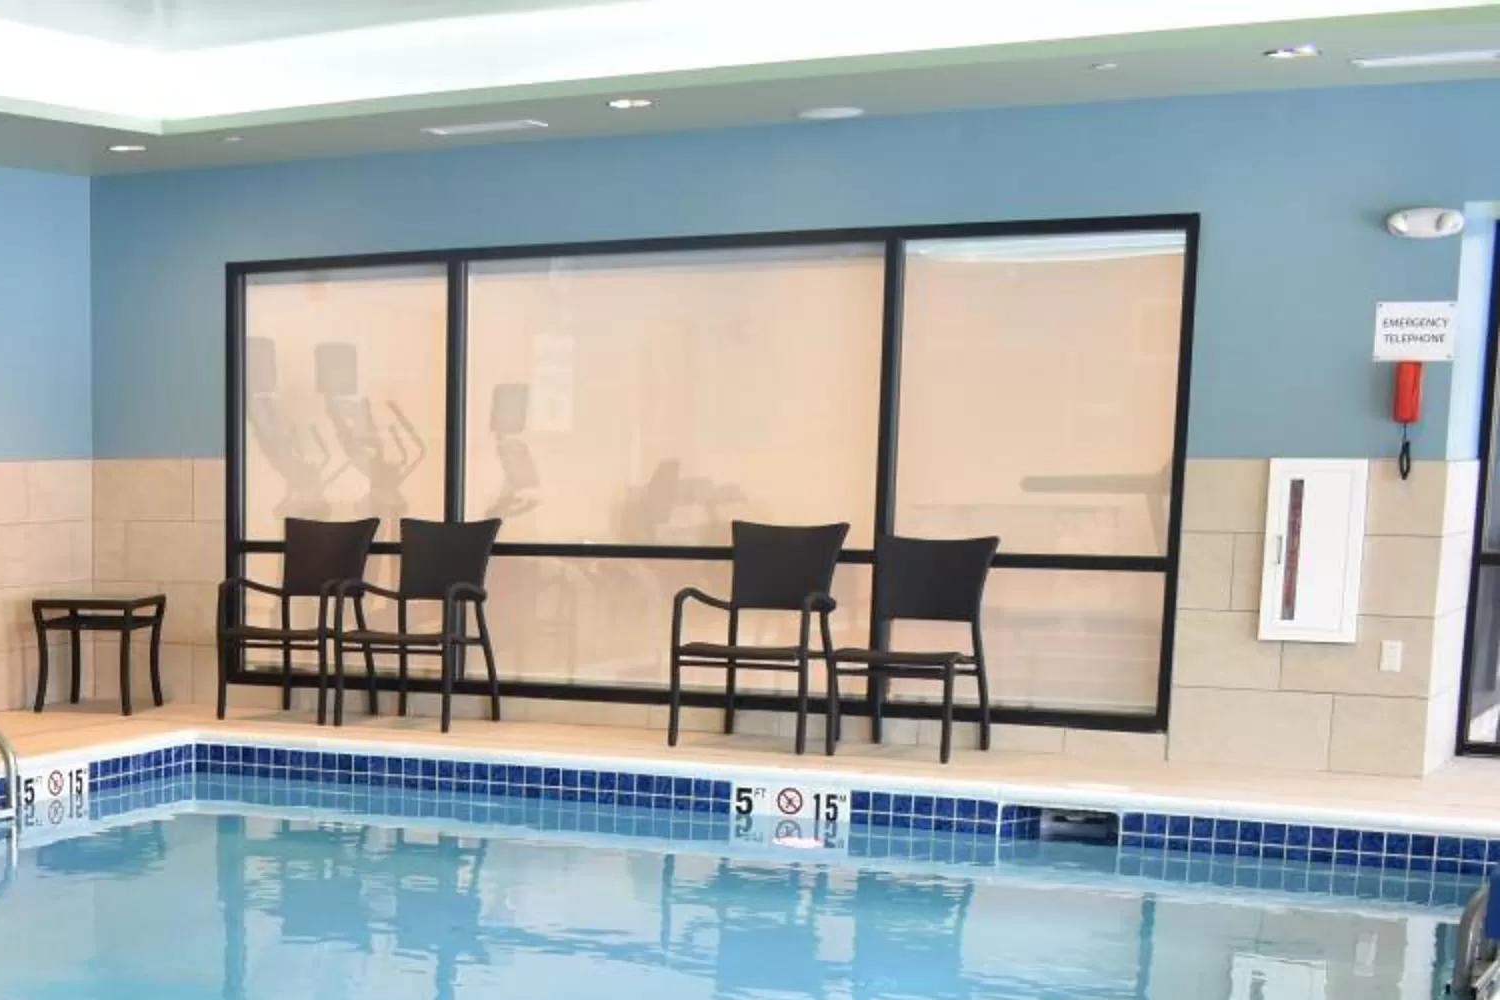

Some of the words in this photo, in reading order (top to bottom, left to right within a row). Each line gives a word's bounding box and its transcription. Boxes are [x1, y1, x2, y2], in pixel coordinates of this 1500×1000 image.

[1382, 316, 1449, 328] EMERGENCY
[1383, 333, 1445, 344] TELEPHONE
[24, 777, 35, 804] 5
[735, 787, 753, 815] 5
